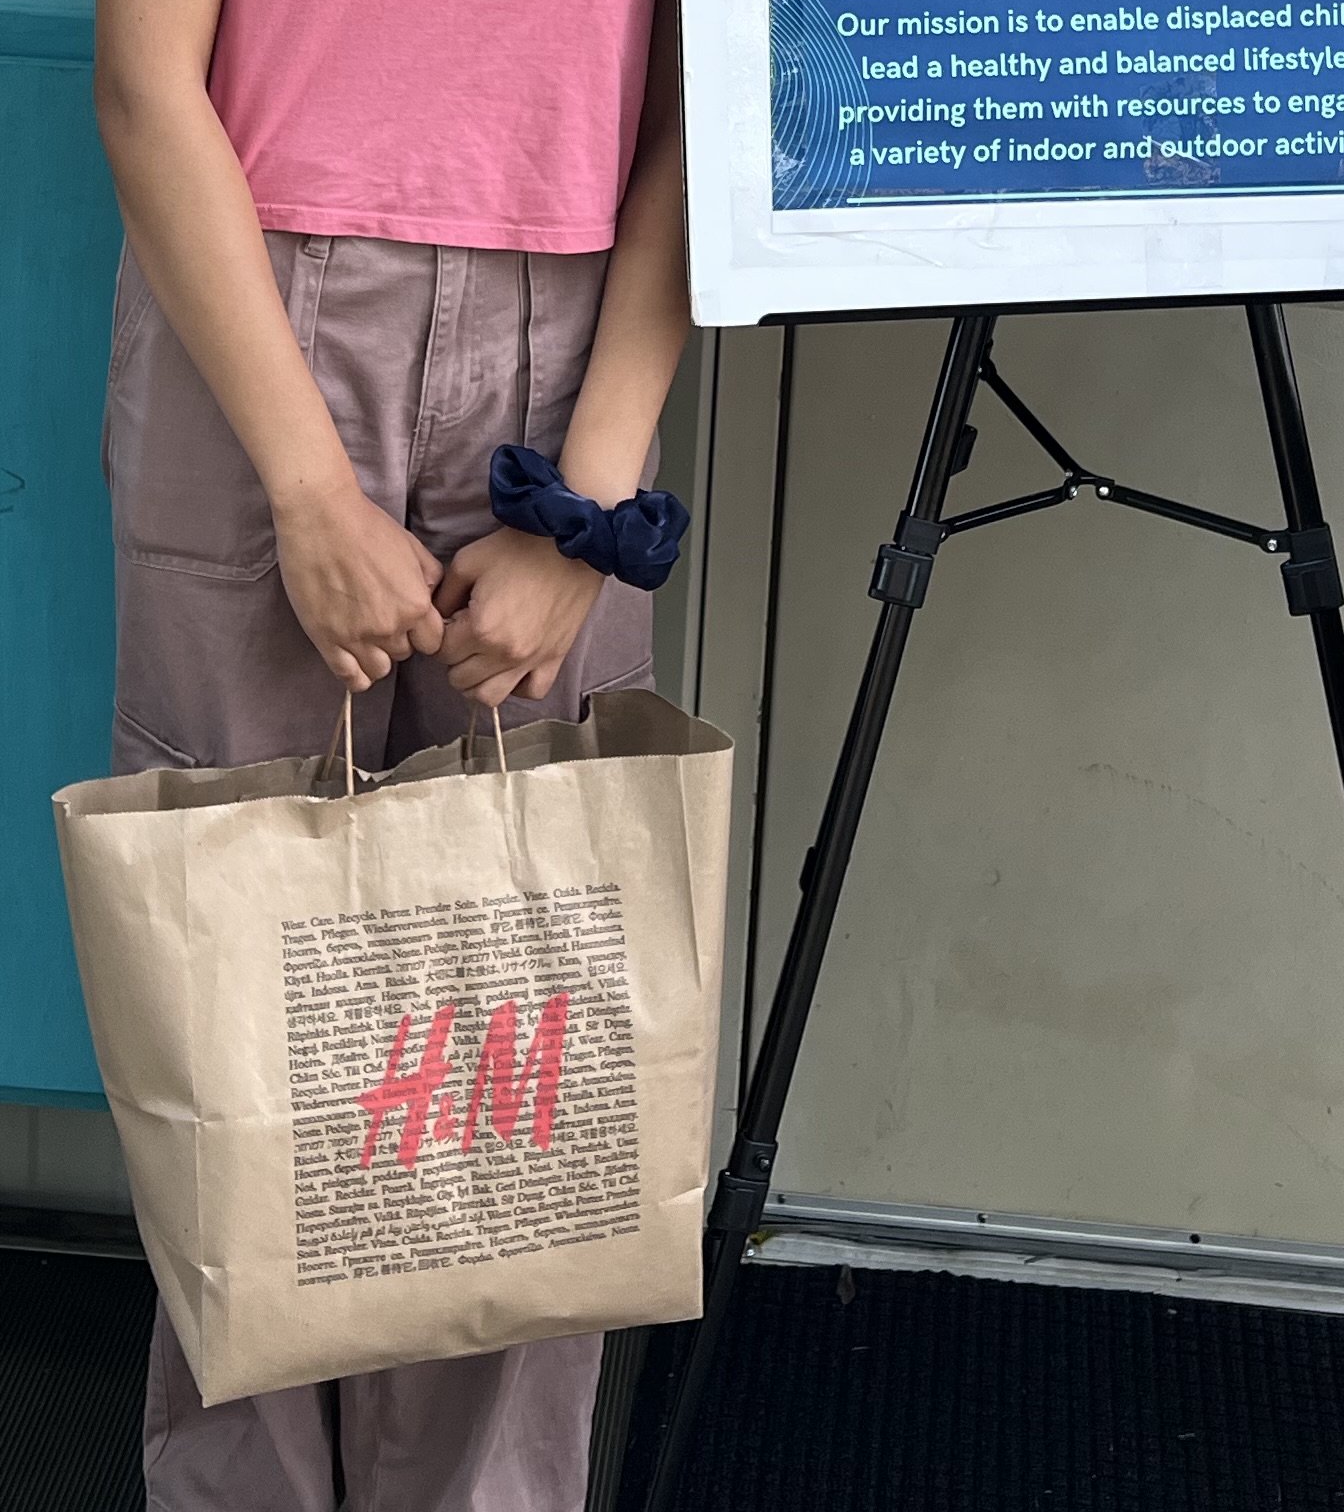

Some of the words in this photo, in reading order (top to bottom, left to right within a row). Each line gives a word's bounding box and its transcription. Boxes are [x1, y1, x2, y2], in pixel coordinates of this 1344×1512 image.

[837, 12, 890, 37] Our
[897, 10, 999, 36] mission
[1007, 9, 1029, 33] is
[1034, 9, 1064, 32] to
[1070, 6, 1159, 32] enable
[1166, 3, 1292, 36] displaced
[861, 54, 919, 80] lead
[926, 60, 943, 78] a
[950, 52, 1052, 82] healthy
[1059, 50, 1108, 75] and
[1116, 47, 1235, 74] balanced
[837, 96, 967, 131] providing
[973, 96, 1043, 120] them
[1050, 93, 1109, 119] with
[1116, 96, 1246, 117] resources
[1252, 90, 1281, 114] to
[849, 144, 865, 166] a
[871, 139, 968, 170] variety
[973, 138, 1001, 162] of
[1008, 137, 1097, 162] indoor
[1103, 135, 1155, 160] and
[1157, 133, 1269, 162] outdoor
[355, 991, 571, 1170] H&M
